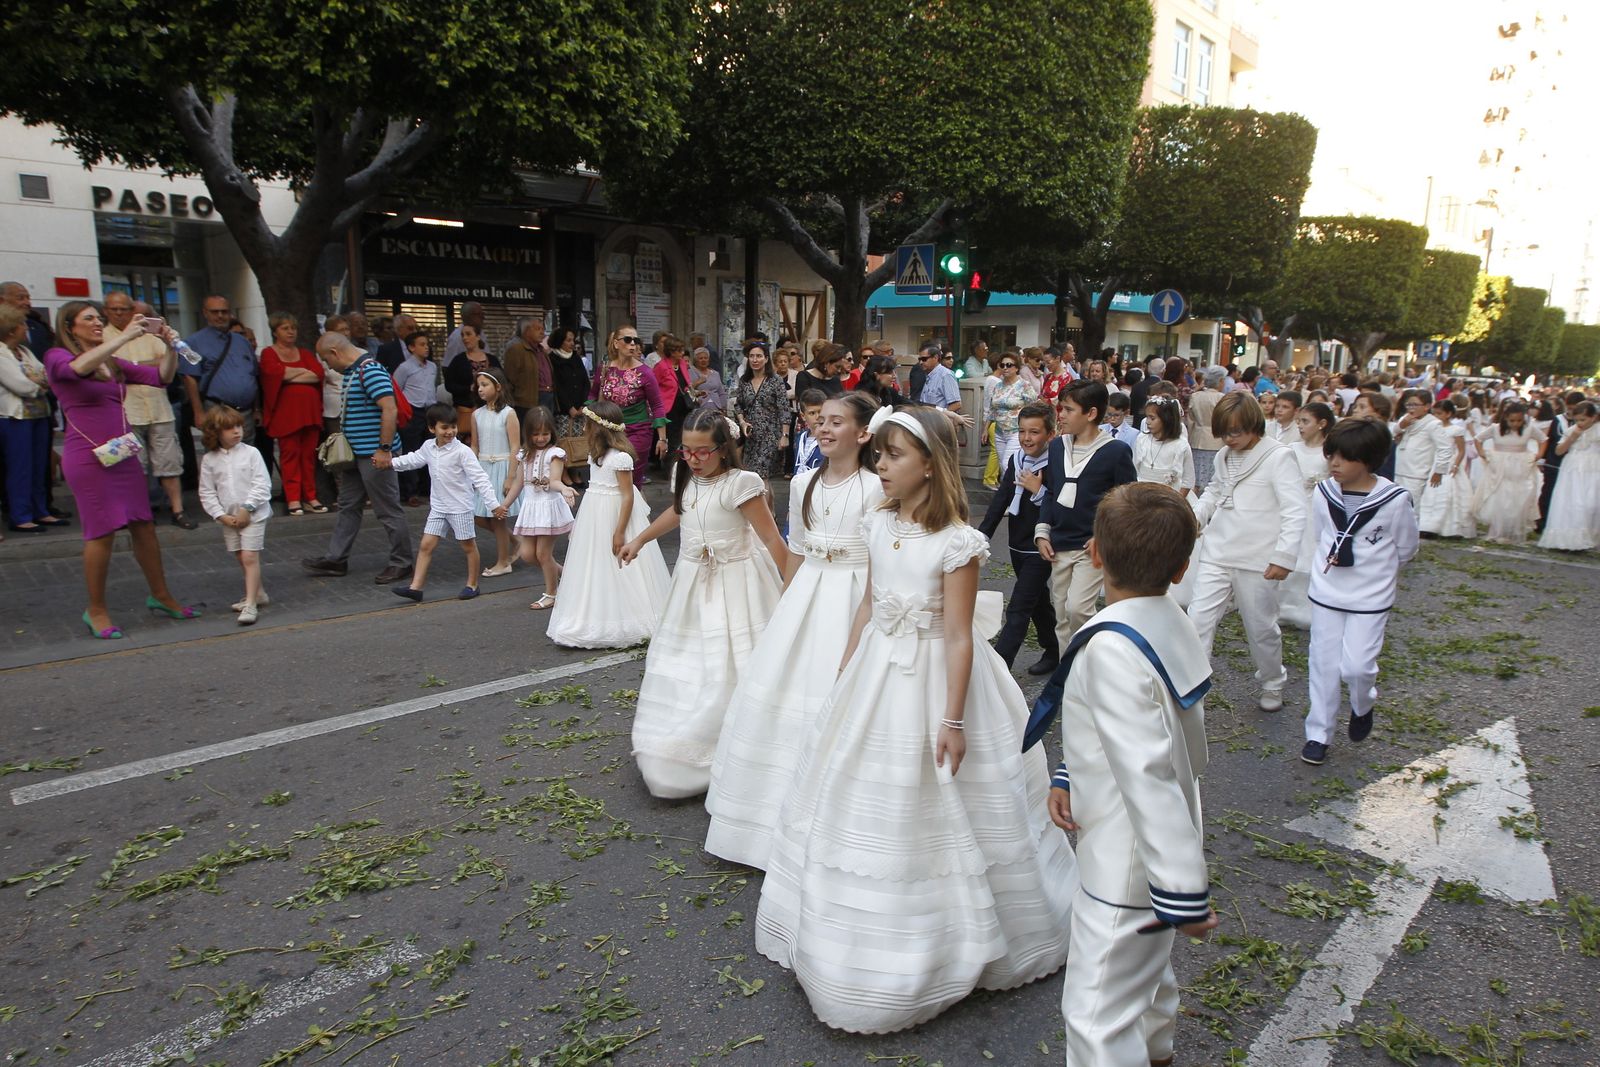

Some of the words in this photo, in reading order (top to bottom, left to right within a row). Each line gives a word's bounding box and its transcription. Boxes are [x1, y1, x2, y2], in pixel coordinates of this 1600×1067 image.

[91, 186, 214, 218] PASEO
[403, 285, 422, 295] un
[426, 286, 469, 297] museo
[472, 288, 488, 298] en
[491, 286, 503, 298] la
[505, 288, 535, 299] calle
[1421, 342, 1434, 356] P
